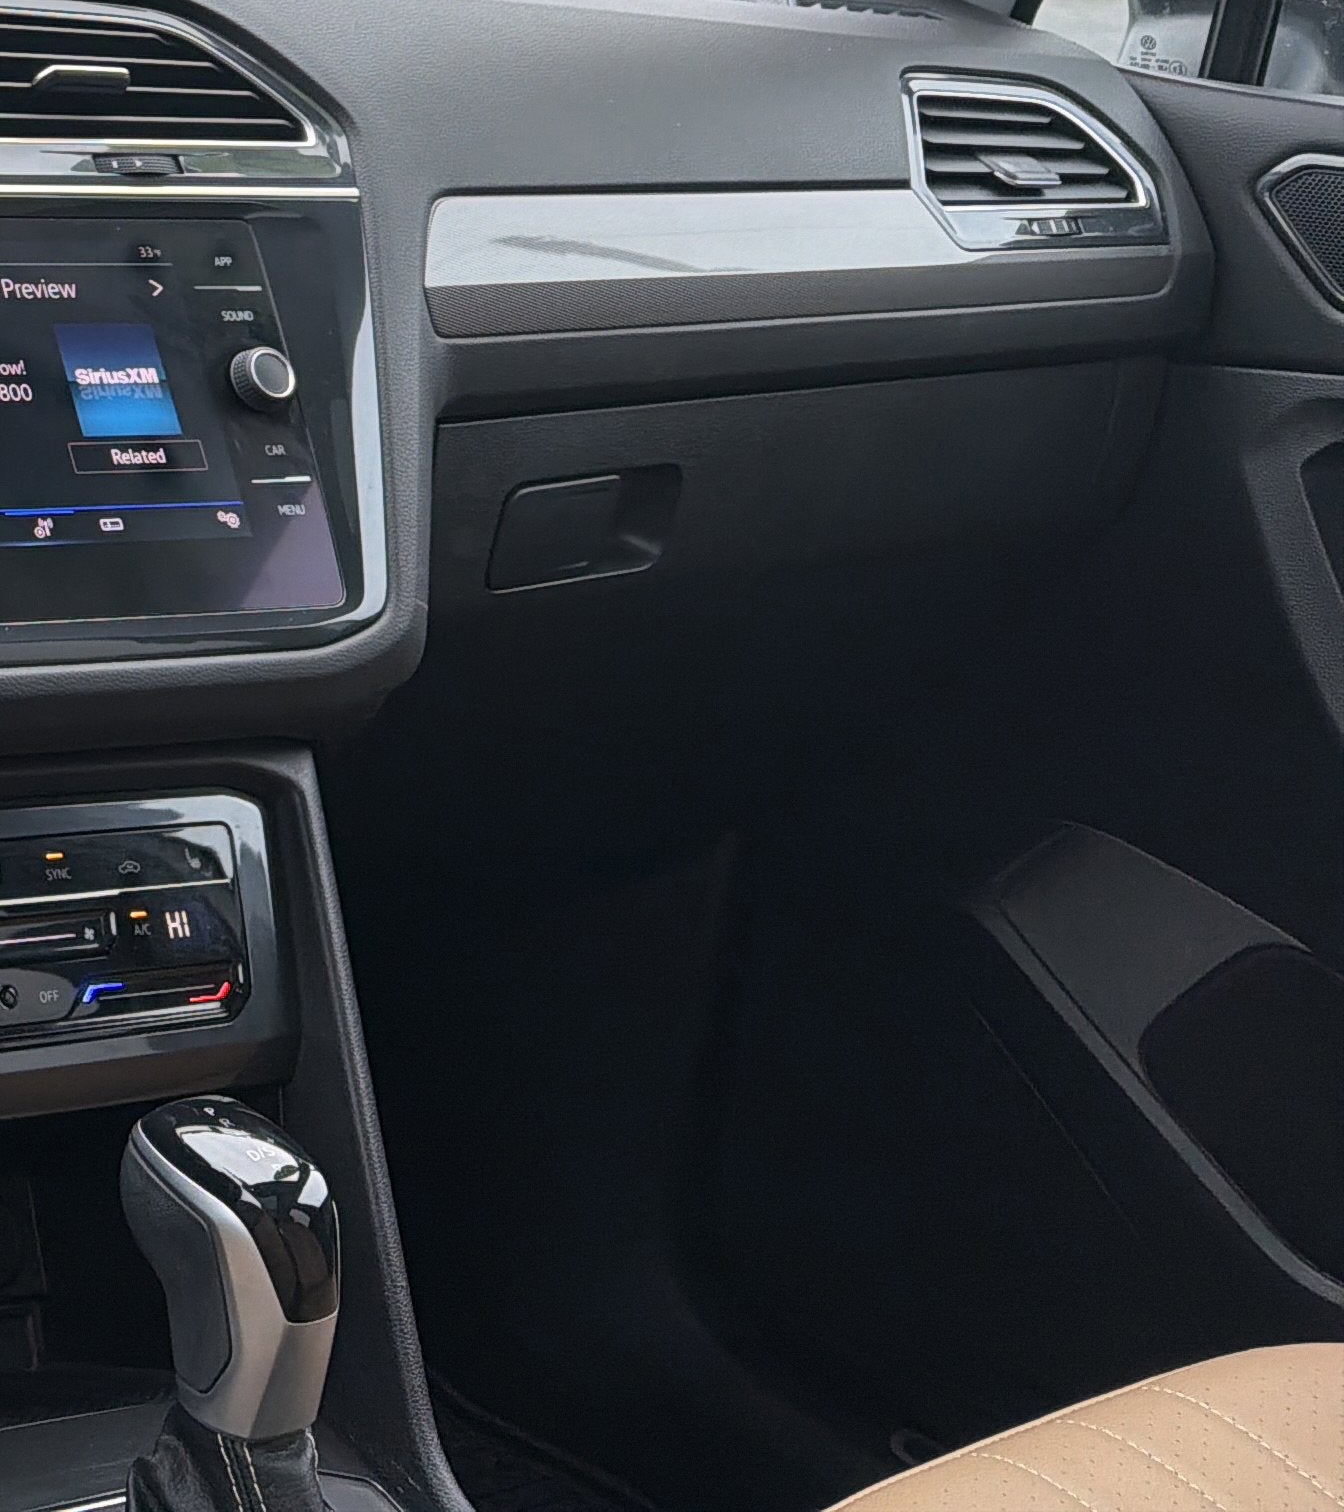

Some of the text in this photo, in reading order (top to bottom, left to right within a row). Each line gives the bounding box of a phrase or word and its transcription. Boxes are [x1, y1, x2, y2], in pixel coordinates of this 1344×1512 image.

[214, 256, 233, 267] APP
[0, 278, 77, 300] Preview
[221, 311, 255, 322] SOUND
[74, 368, 160, 385] SiriusXM
[111, 449, 167, 465] Related
[264, 445, 286, 456] CAR
[277, 504, 306, 516] MENU
[45, 866, 73, 882] SYNC
[133, 922, 152, 936] A/C
[165, 911, 192, 940] HI
[39, 990, 60, 1004] OFF
[245, 1146, 277, 1162] D/S
